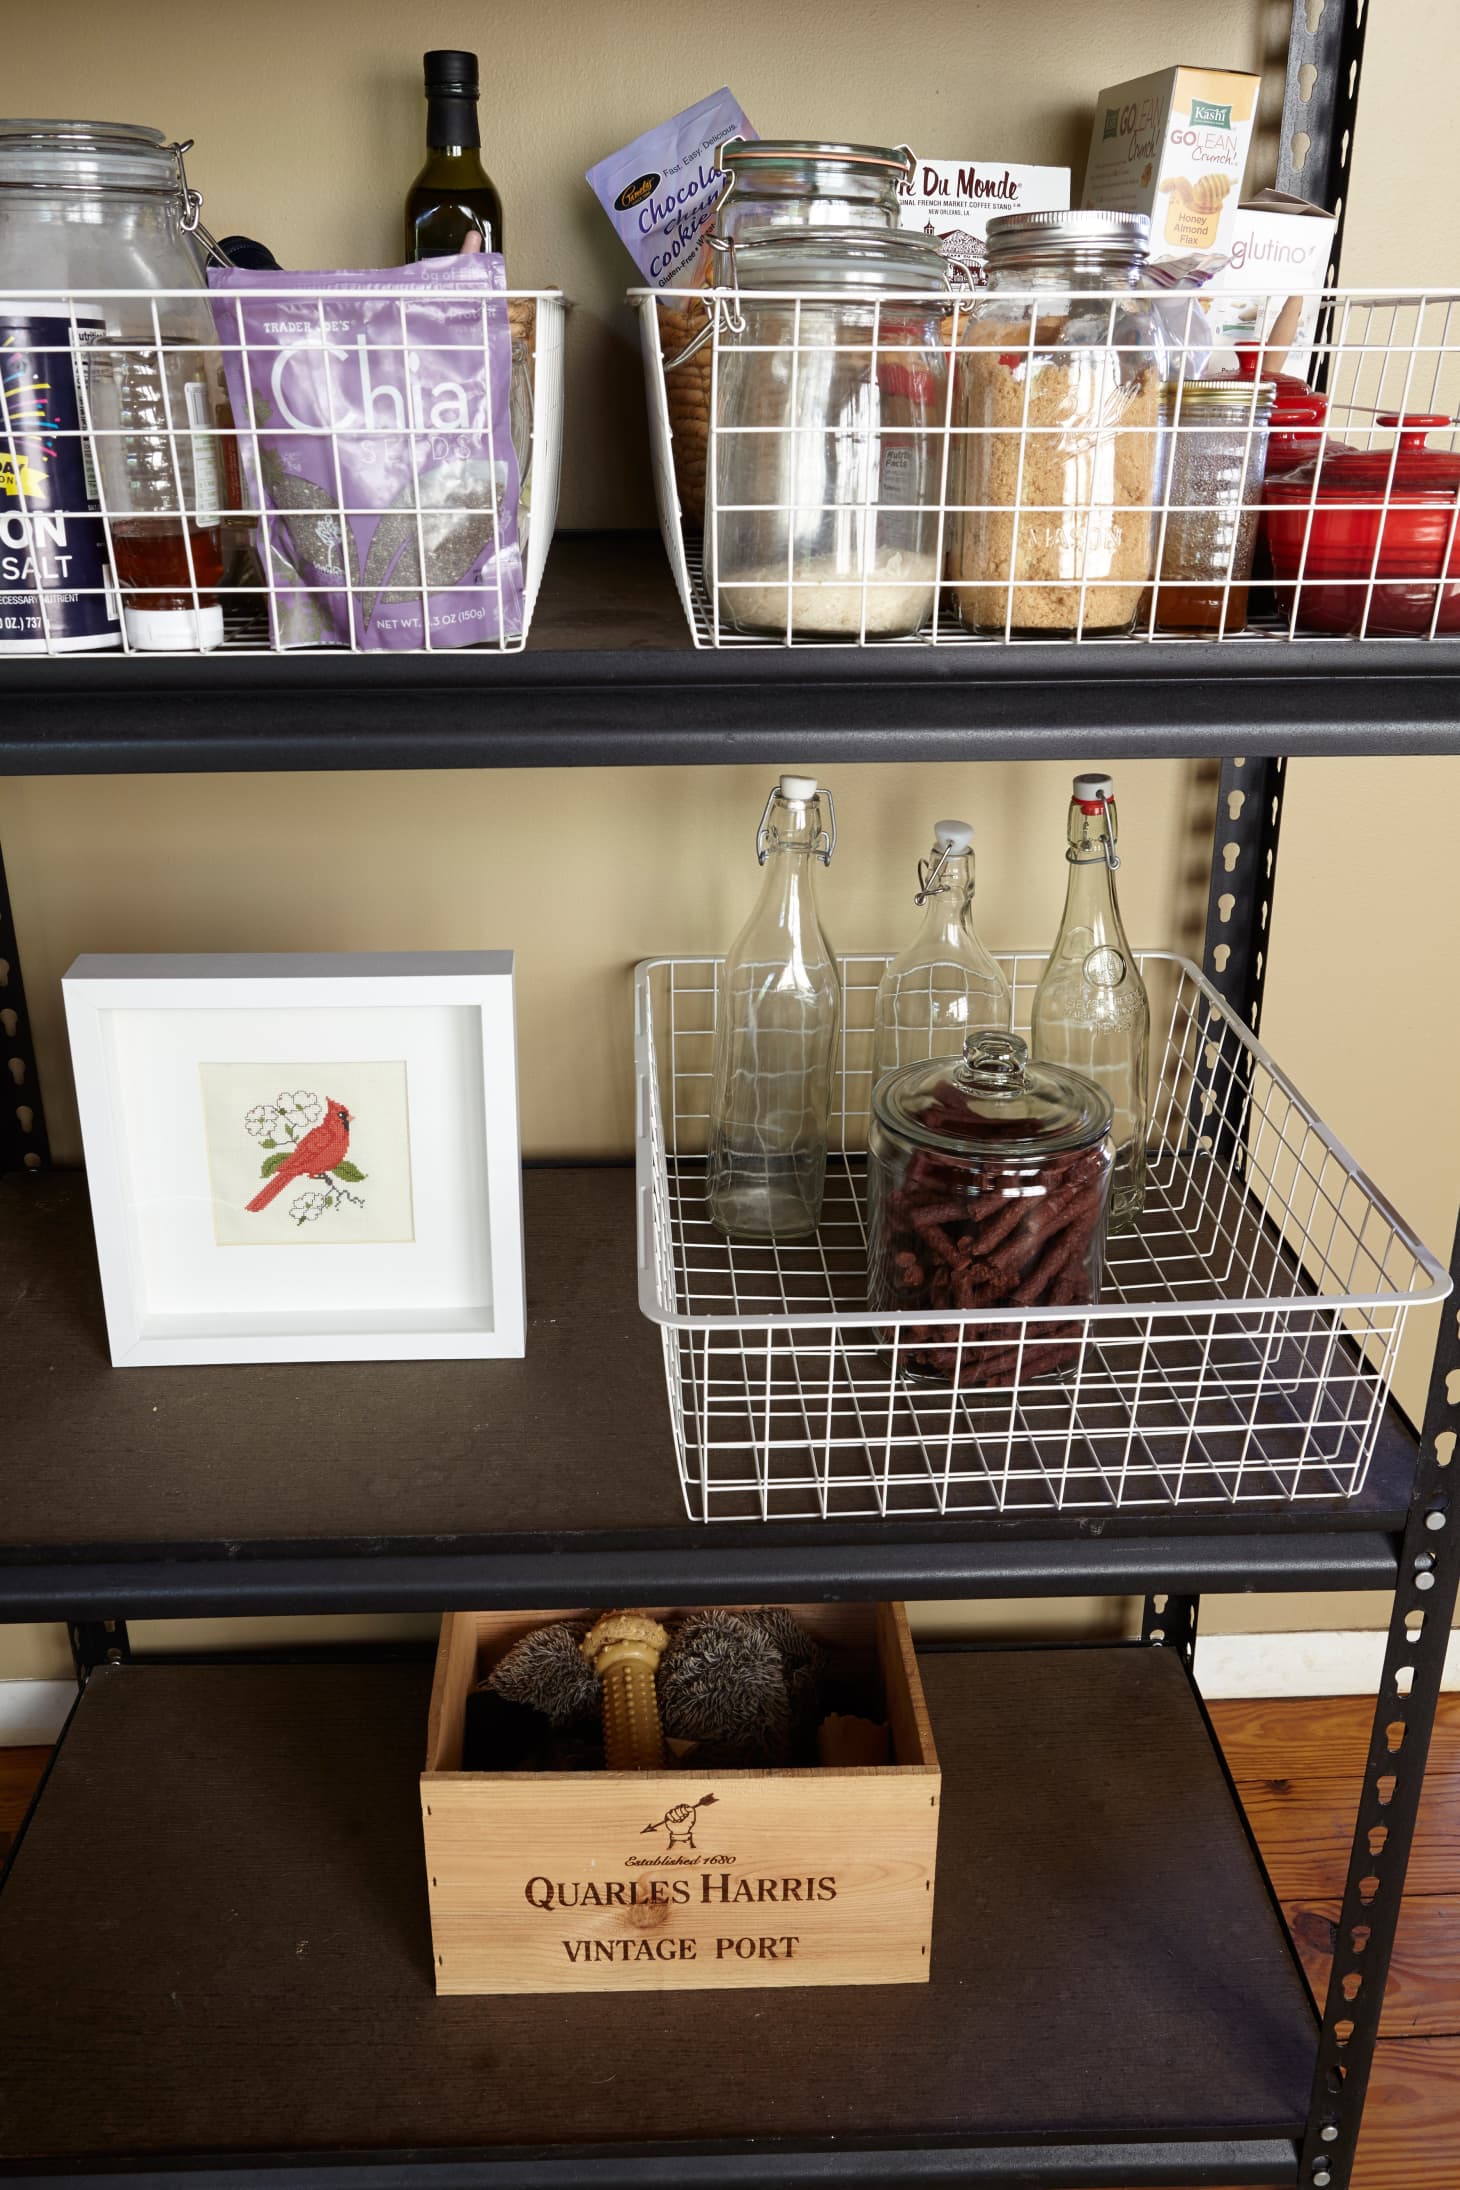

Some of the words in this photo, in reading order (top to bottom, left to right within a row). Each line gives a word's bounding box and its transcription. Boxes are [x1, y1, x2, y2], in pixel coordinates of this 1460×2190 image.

[1194, 106, 1226, 122] Kashi
[662, 163, 684, 178] Fast.
[682, 148, 703, 166] Easy.
[1191, 146, 1238, 167] Crunch!
[922, 166, 951, 197] Du
[956, 166, 1019, 201] Monde
[917, 199, 942, 207] FRENCH
[943, 200, 968, 208] MARKET
[968, 201, 991, 209] COFFEE
[992, 202, 1012, 211] STAND
[1173, 223, 1209, 236] Almond
[1178, 213, 1208, 226] Honey
[1179, 234, 1199, 246] Flax
[1229, 231, 1306, 270] glutino
[658, 250, 696, 288] Gluten-Free
[263, 321, 312, 334] TRADER
[315, 320, 351, 334] OE'S
[270, 333, 473, 434] Chia
[359, 433, 472, 465] SEDS
[1, 555, 73, 580] SALT
[5, 616, 24, 631] OZ.)
[25, 616, 42, 630] 737
[376, 619, 399, 630] NET
[400, 618, 422, 629] WT.
[441, 614, 457, 625] OZ
[458, 607, 486, 623] (150g)
[624, 1854, 702, 1867] Established
[702, 1854, 738, 1866] 1680
[524, 1875, 692, 1912] QUARLES
[700, 1873, 838, 1904] HARRIS
[561, 1937, 697, 1963] VINTAGE
[715, 1935, 800, 1960] PORT
